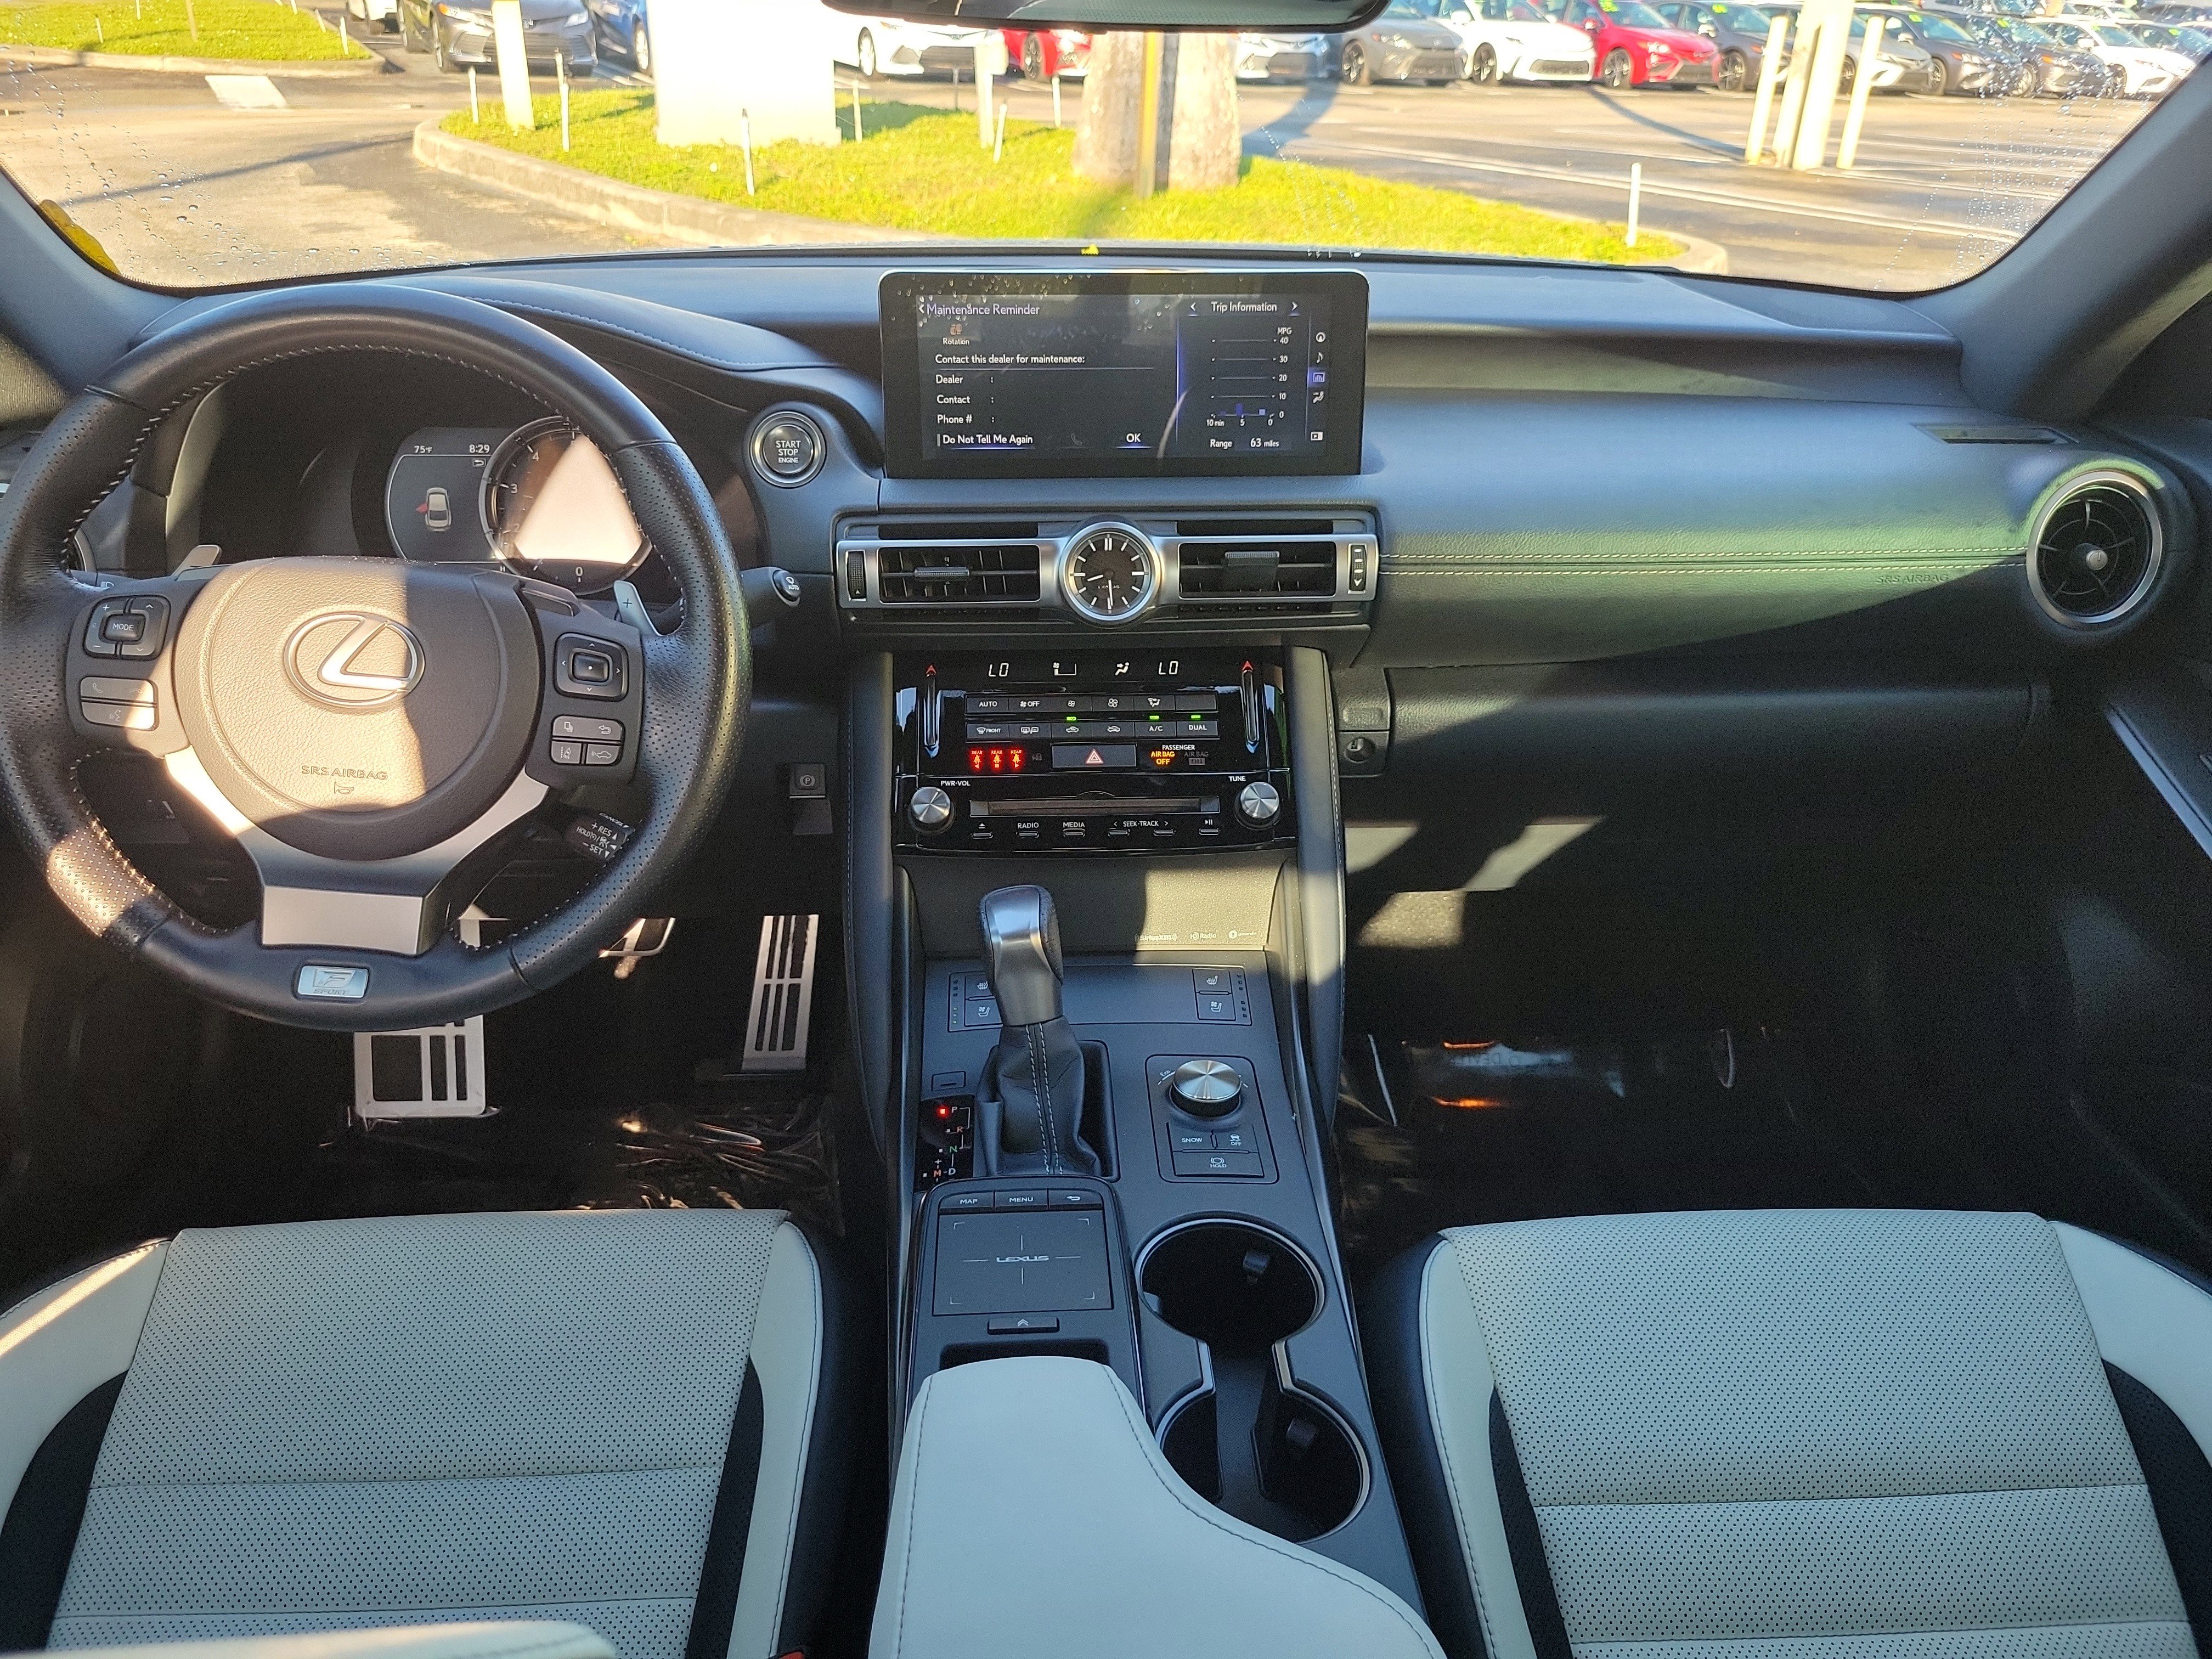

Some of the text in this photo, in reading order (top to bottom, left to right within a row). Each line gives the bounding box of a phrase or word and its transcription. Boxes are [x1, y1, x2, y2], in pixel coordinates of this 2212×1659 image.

[927, 303, 1040, 315] Maintenance Reminder
[1211, 302, 1277, 313] Trip Information
[935, 354, 1085, 364] Contact this dealer for maintenance:
[936, 375, 963, 384] Dealer
[936, 396, 970, 404] Contact
[937, 415, 963, 424] Phone
[943, 435, 1033, 445] Do Not Tell Me Again
[1126, 433, 1141, 443] OK
[1210, 439, 1232, 449] Range
[1250, 438, 1261, 447] 63
[469, 445, 490, 453] 8:29
[532, 452, 539, 461] 4
[511, 484, 518, 493] 3
[576, 567, 583, 576] 0
[1876, 574, 1900, 584] SRS
[112, 623, 134, 631] MODE
[302, 765, 388, 780] SRS AIRBAG
[576, 826, 591, 837] HOLD
[598, 826, 612, 837] RES
[590, 844, 603, 855] SET
